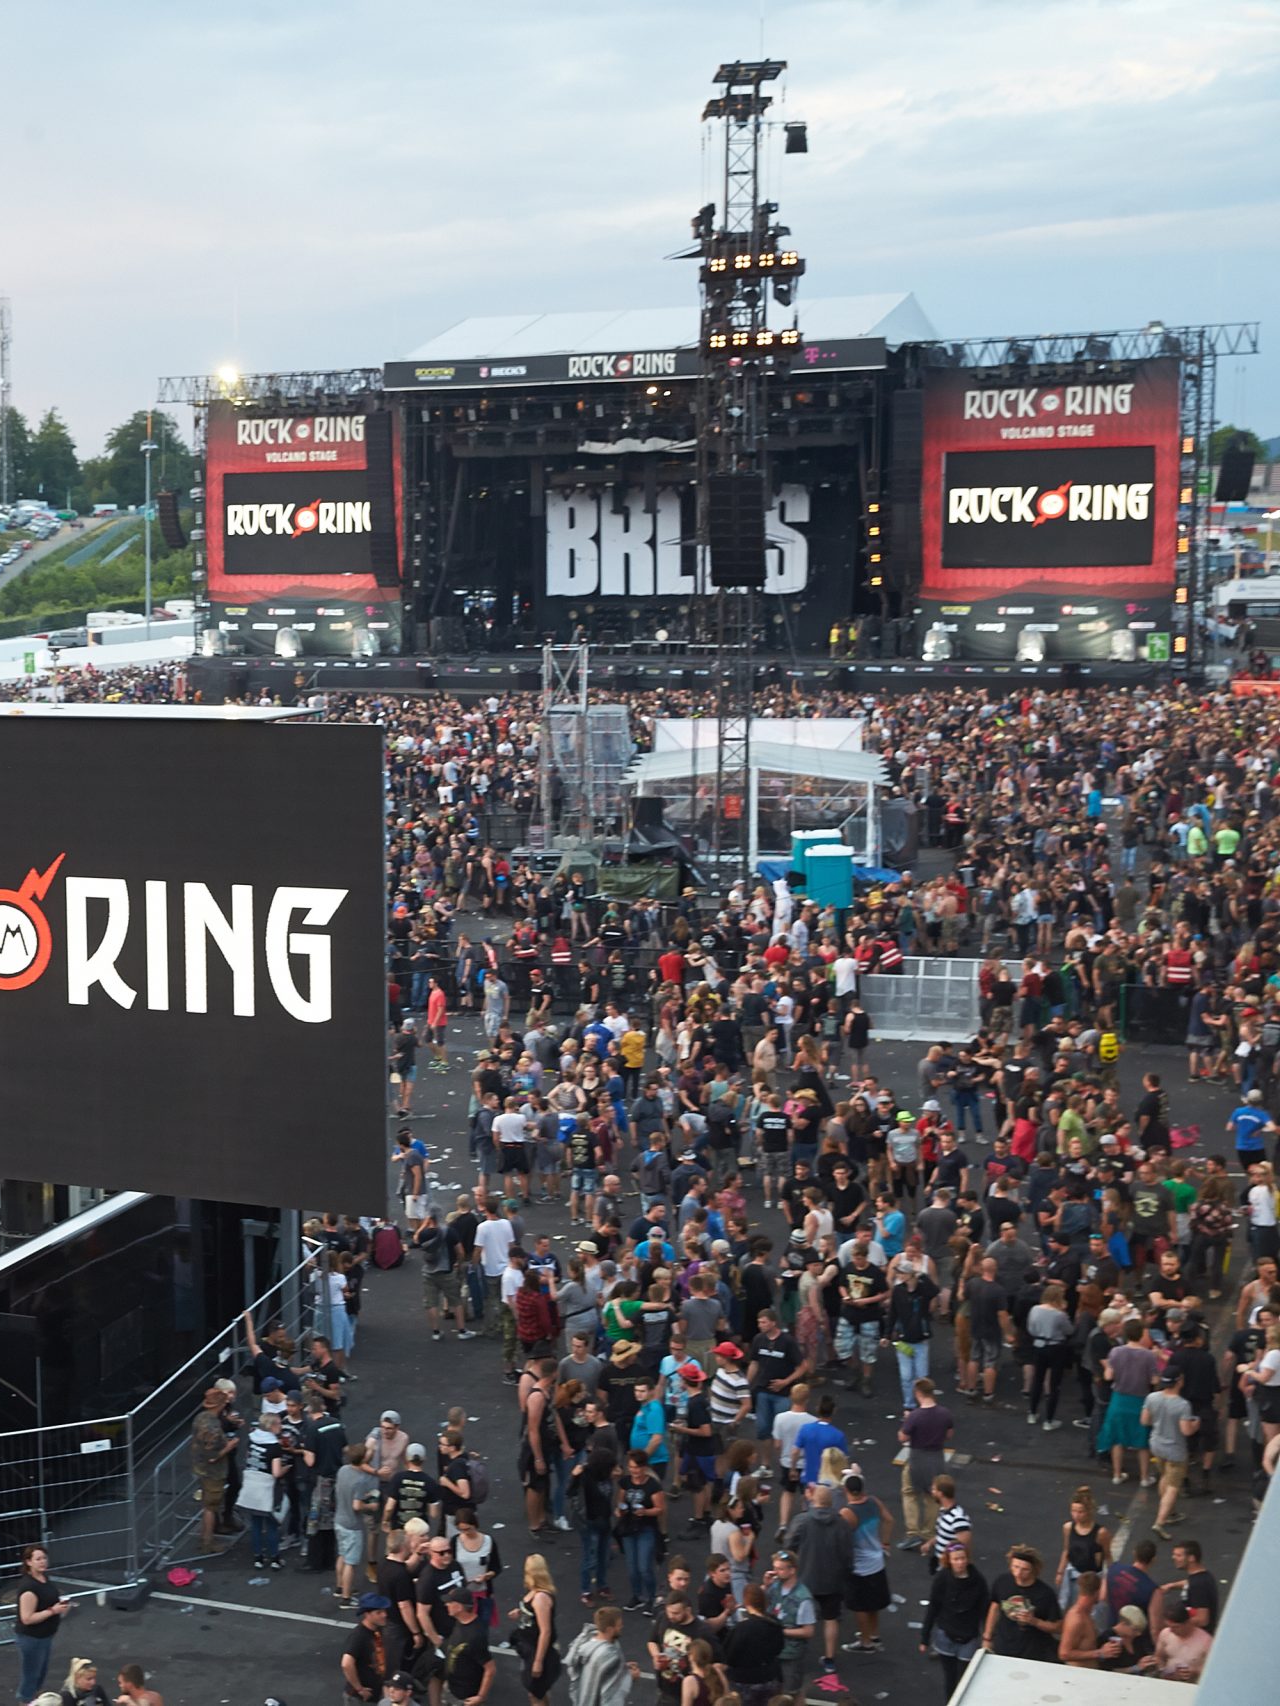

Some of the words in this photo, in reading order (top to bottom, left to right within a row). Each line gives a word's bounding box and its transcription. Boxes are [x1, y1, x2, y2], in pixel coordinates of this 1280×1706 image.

[568, 355, 617, 377] ROCK
[633, 353, 677, 375] RING
[964, 388, 1038, 419] ROCK
[1065, 384, 1134, 416] RING
[237, 418, 294, 445] ROCK
[314, 415, 366, 442] RING
[1000, 426, 1053, 439] VOLCANO
[1057, 424, 1095, 437] STAGE
[265, 451, 306, 462] VOLCANO
[309, 450, 337, 461] STAGE
[948, 486, 1039, 523] ROCK
[1069, 483, 1153, 521] RING
[227, 503, 295, 535] ROCK
[66, 876, 349, 1023] RING
